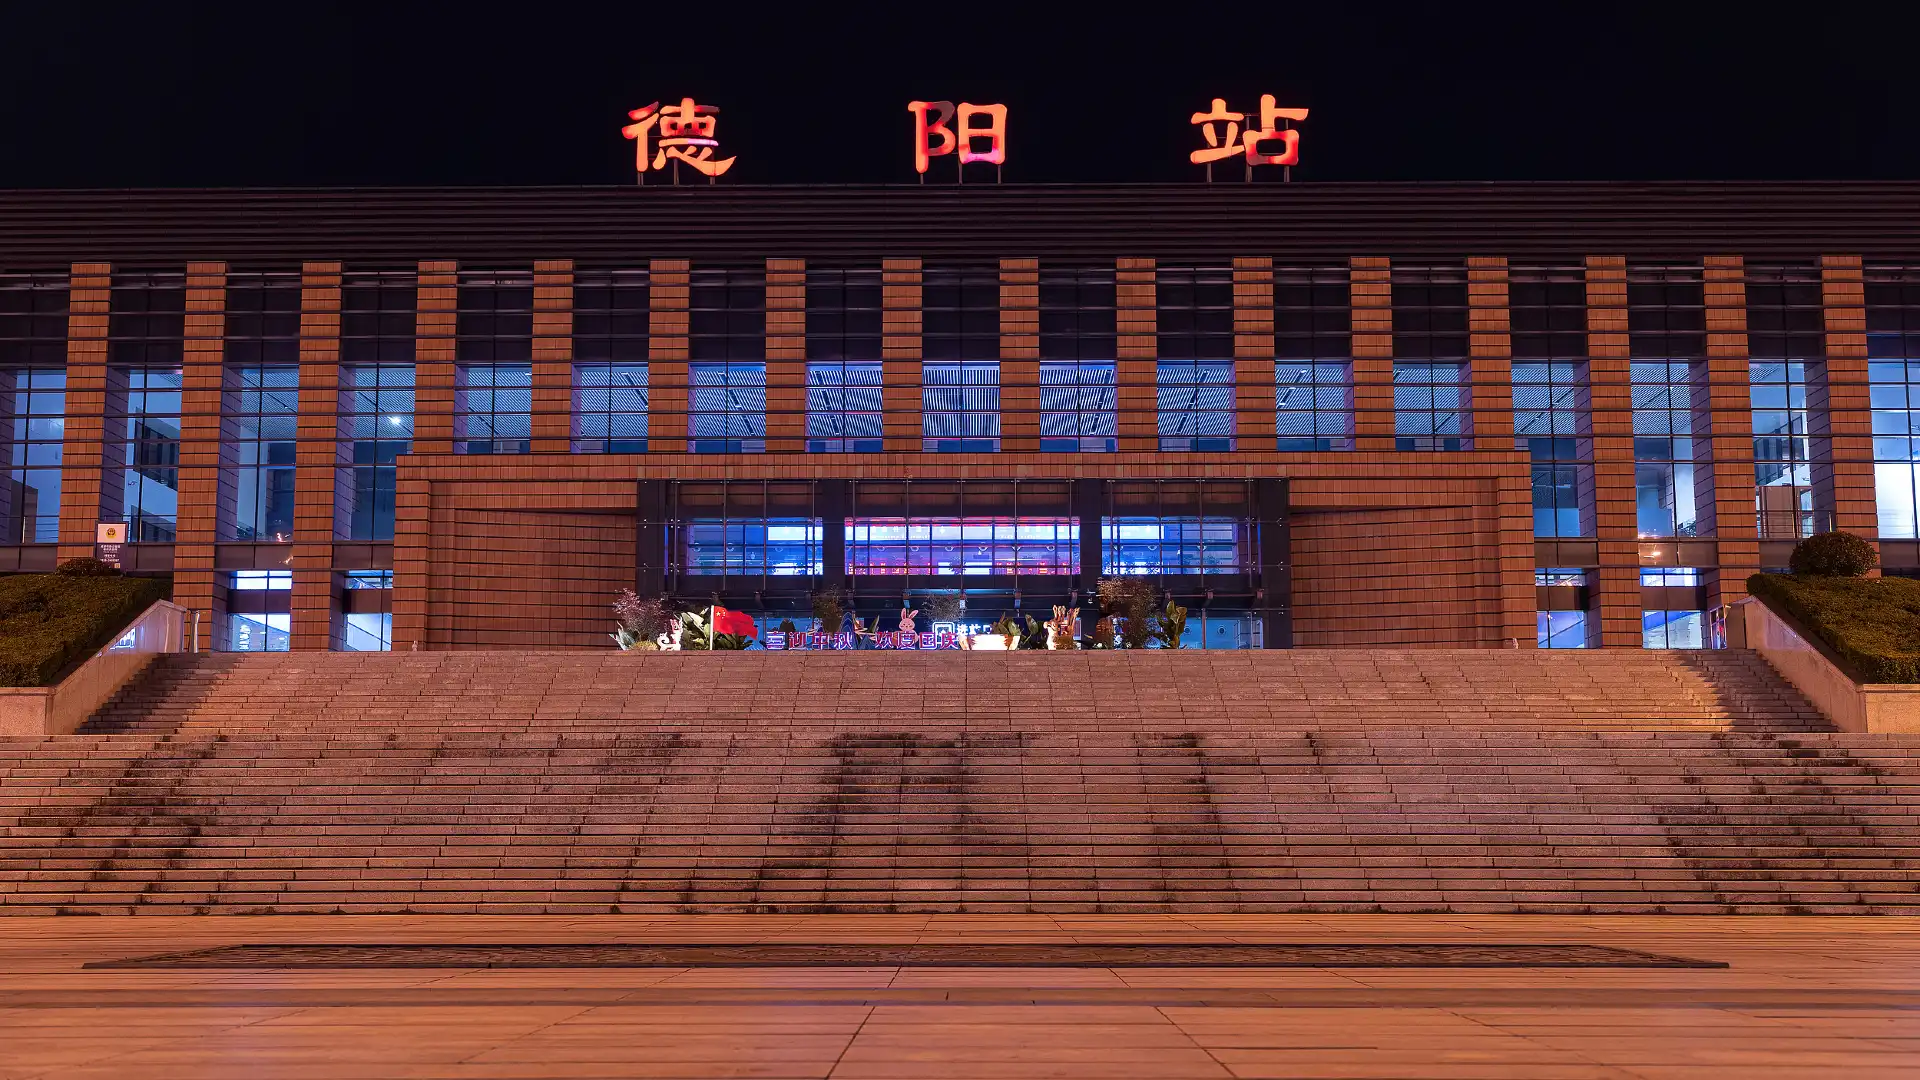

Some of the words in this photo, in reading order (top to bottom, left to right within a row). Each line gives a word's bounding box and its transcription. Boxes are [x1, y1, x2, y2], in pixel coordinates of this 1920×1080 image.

[622, 94, 1309, 176] 德阳站
[766, 631, 853, 650] 喜迎中秋
[875, 631, 959, 650] 欢度国庆
